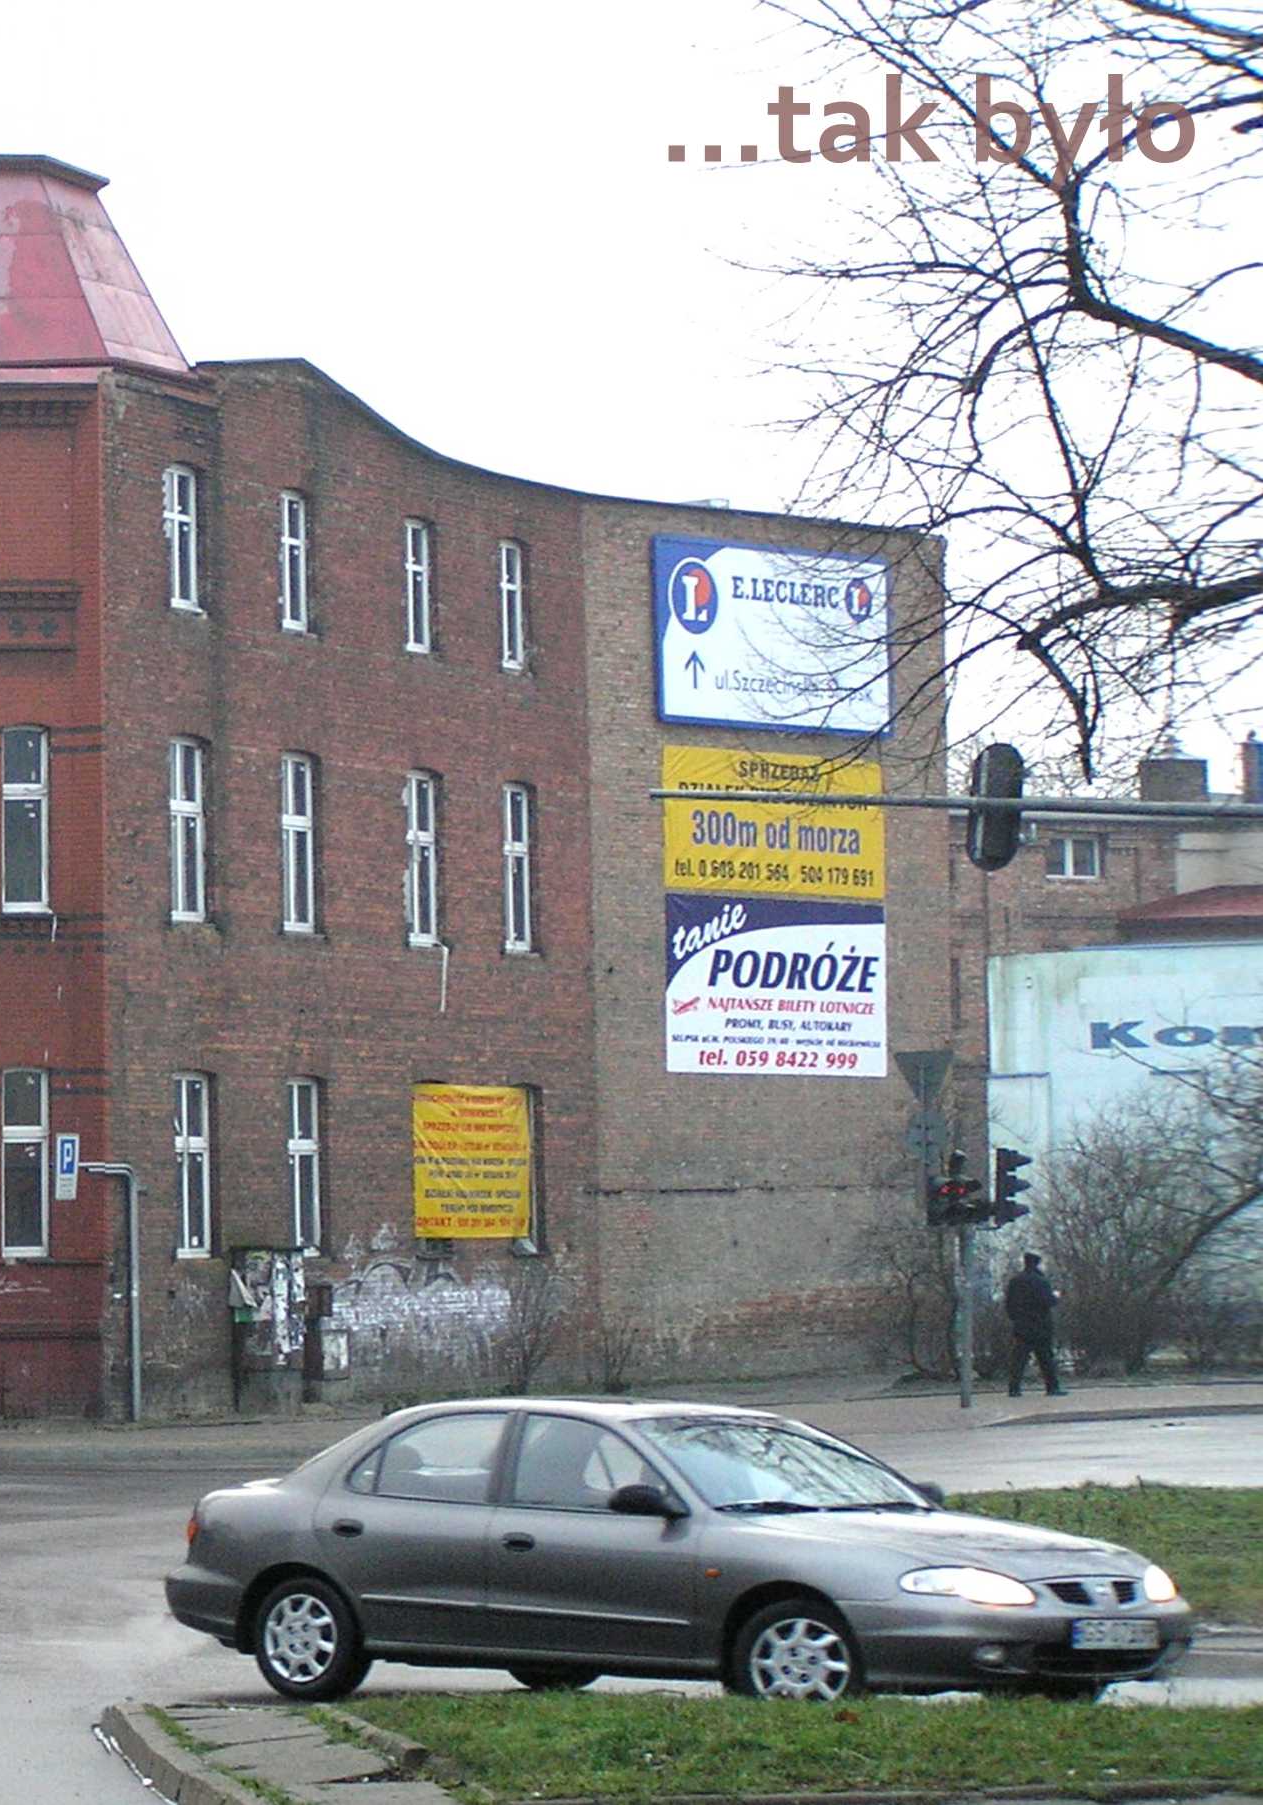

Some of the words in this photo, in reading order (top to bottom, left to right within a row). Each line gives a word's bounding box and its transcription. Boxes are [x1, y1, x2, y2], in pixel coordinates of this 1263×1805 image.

[731, 576, 840, 609] E.LECLERC
[692, 810, 757, 848] 300m
[765, 816, 790, 850] od
[798, 824, 861, 855] morza
[675, 859, 694, 877] tel.
[698, 860, 706, 876] 0
[739, 862, 760, 880] 201
[766, 864, 789, 882] 564
[801, 865, 823, 884] 504
[828, 867, 848, 885] 179
[853, 868, 874, 887] 691
[673, 903, 747, 960] tanie
[707, 942, 880, 993] PODRÓŻE
[778, 999, 815, 1013] BILETY
[820, 1000, 875, 1015] LOTNICZE
[800, 1021, 853, 1032] AUTOKARY
[699, 1049, 727, 1065] tel.
[736, 1050, 769, 1067] 059
[775, 1051, 818, 1068] 8422
[826, 1052, 858, 1069] 999
[63, 1143, 73, 1171] P
